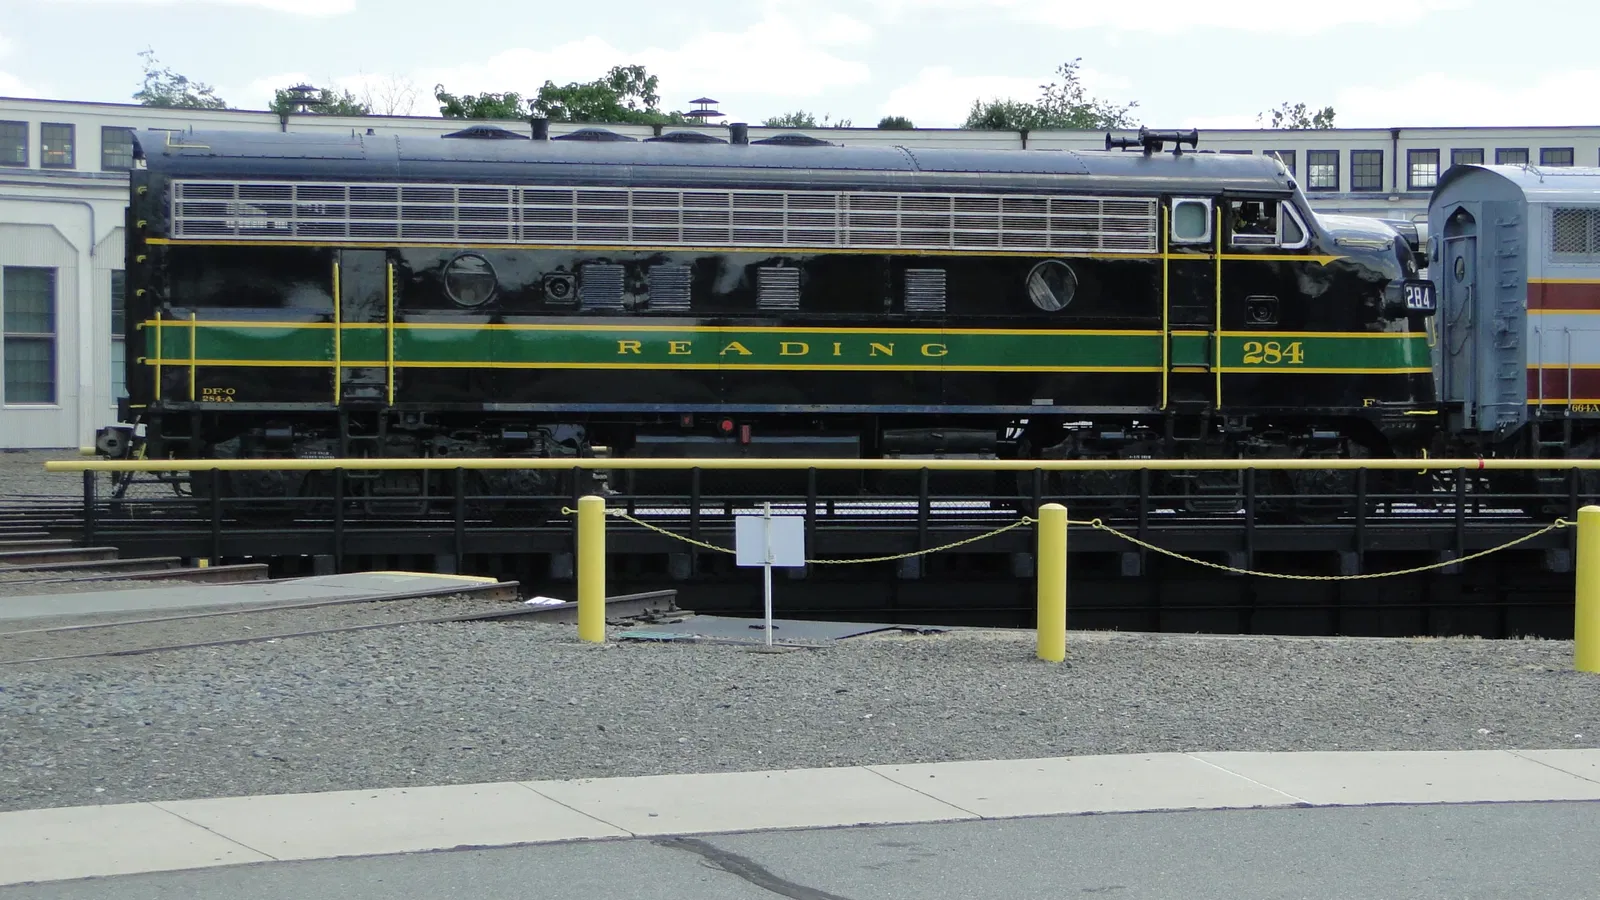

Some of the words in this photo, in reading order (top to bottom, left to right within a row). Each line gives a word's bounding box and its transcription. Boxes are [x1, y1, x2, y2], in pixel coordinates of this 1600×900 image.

[1405, 286, 1430, 308] 284
[617, 340, 948, 357] READING
[1243, 341, 1304, 364] 284
[1362, 398, 1376, 408] F
[1571, 404, 1600, 412] 664A
